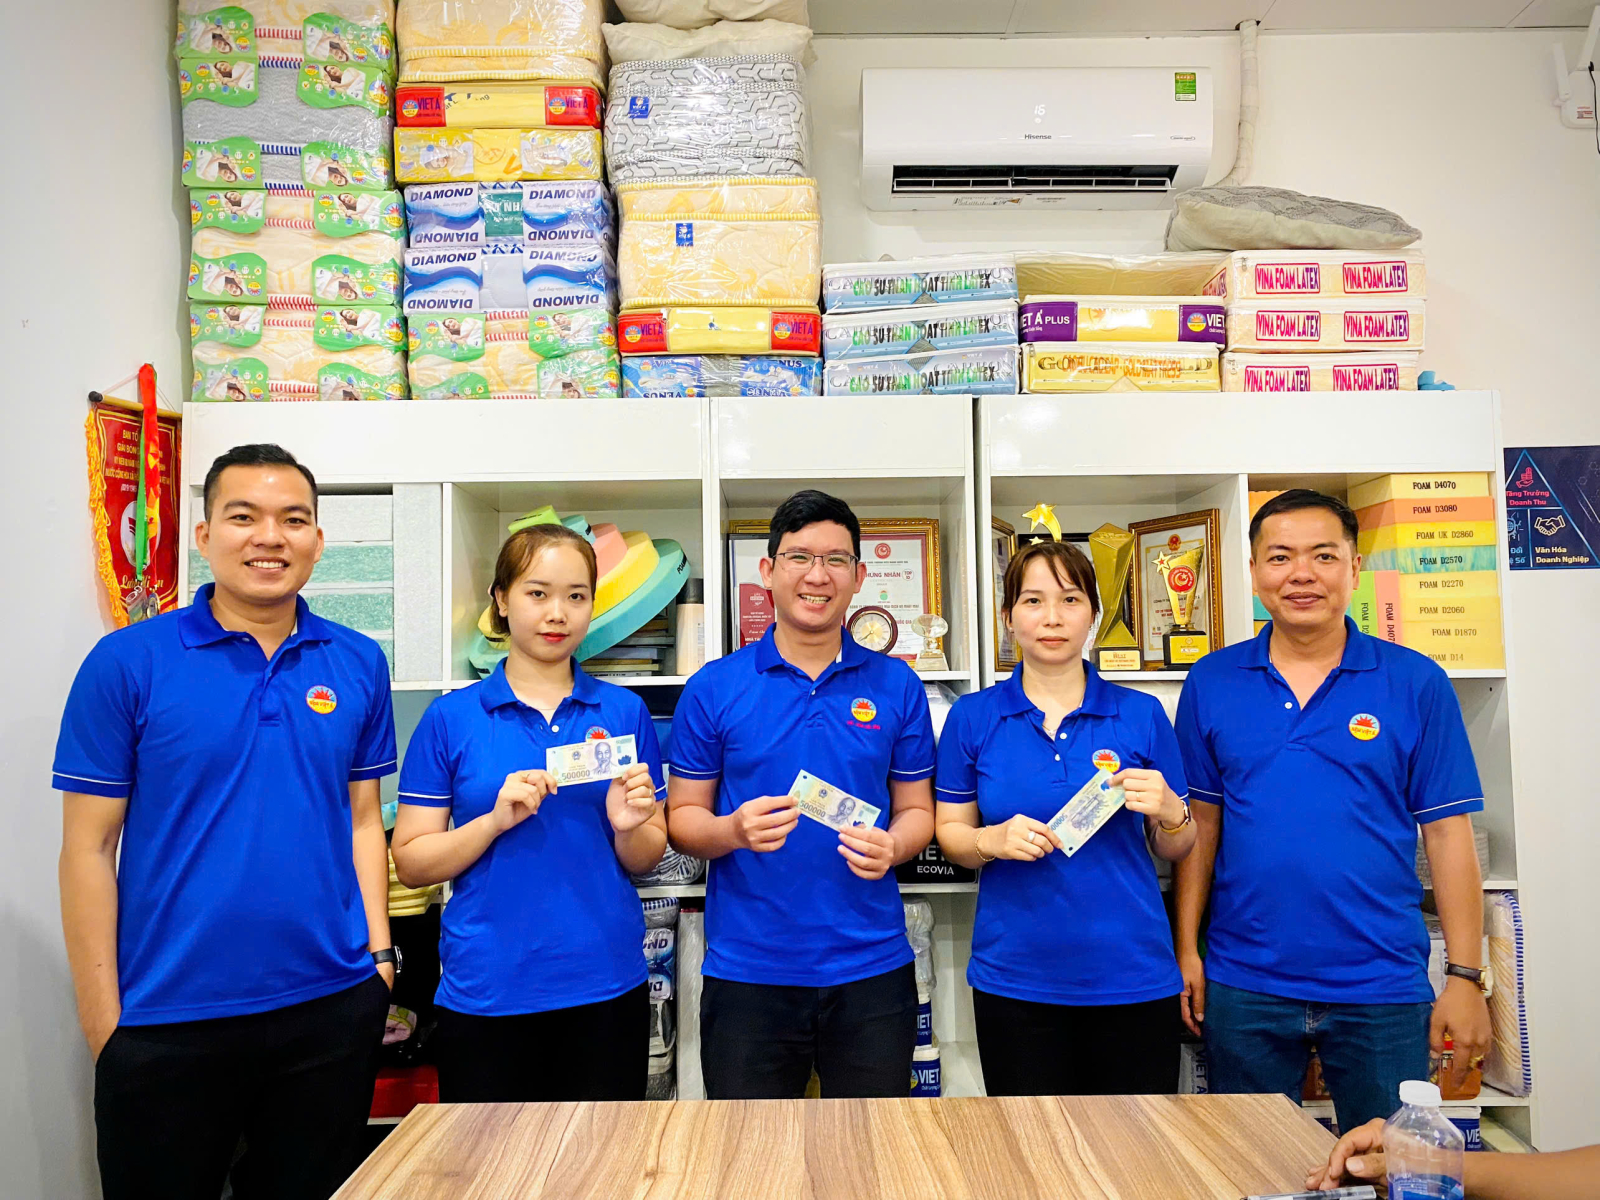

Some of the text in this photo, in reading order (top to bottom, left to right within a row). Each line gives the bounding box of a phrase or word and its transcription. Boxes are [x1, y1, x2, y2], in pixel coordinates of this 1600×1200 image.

[1034, 104, 1046, 116] 16
[410, 187, 474, 202] DIAMOND
[529, 188, 596, 200] DIAMOND
[414, 232, 479, 244] DIAMOND
[528, 230, 594, 240] DIAMOND
[411, 252, 476, 266] DIAMOND
[529, 250, 598, 262] DIAMOND
[1256, 267, 1318, 290] VINA FOAM LATEX
[1344, 265, 1406, 290] VINA FOAM LATEX
[874, 278, 886, 296] SU
[408, 298, 473, 309] DIAMOND
[532, 294, 600, 308] DIAMOND
[1045, 316, 1070, 325] PLUS
[1257, 314, 1319, 337] VINA FOAM LATEX
[1345, 314, 1407, 337] VINA FOAM LATEX
[873, 328, 884, 345] SU
[872, 375, 884, 393] SU
[1246, 370, 1308, 392] VINA FOAM LATEX
[1334, 368, 1398, 392] VINA FOAM LATEX
[1413, 482, 1431, 490] FOAM
[1435, 505, 1457, 513] D3080
[1440, 556, 1463, 564] D2570
[1442, 580, 1463, 588] D2270
[1361, 602, 1369, 621] FOAM
[1385, 602, 1395, 644] FOAM D407
[561, 770, 590, 780] 500000
[800, 800, 826, 818] 500000
[917, 866, 954, 875] ECOVIA
[1196, 1049, 1207, 1080] VIET
[918, 1068, 939, 1084] VIET
